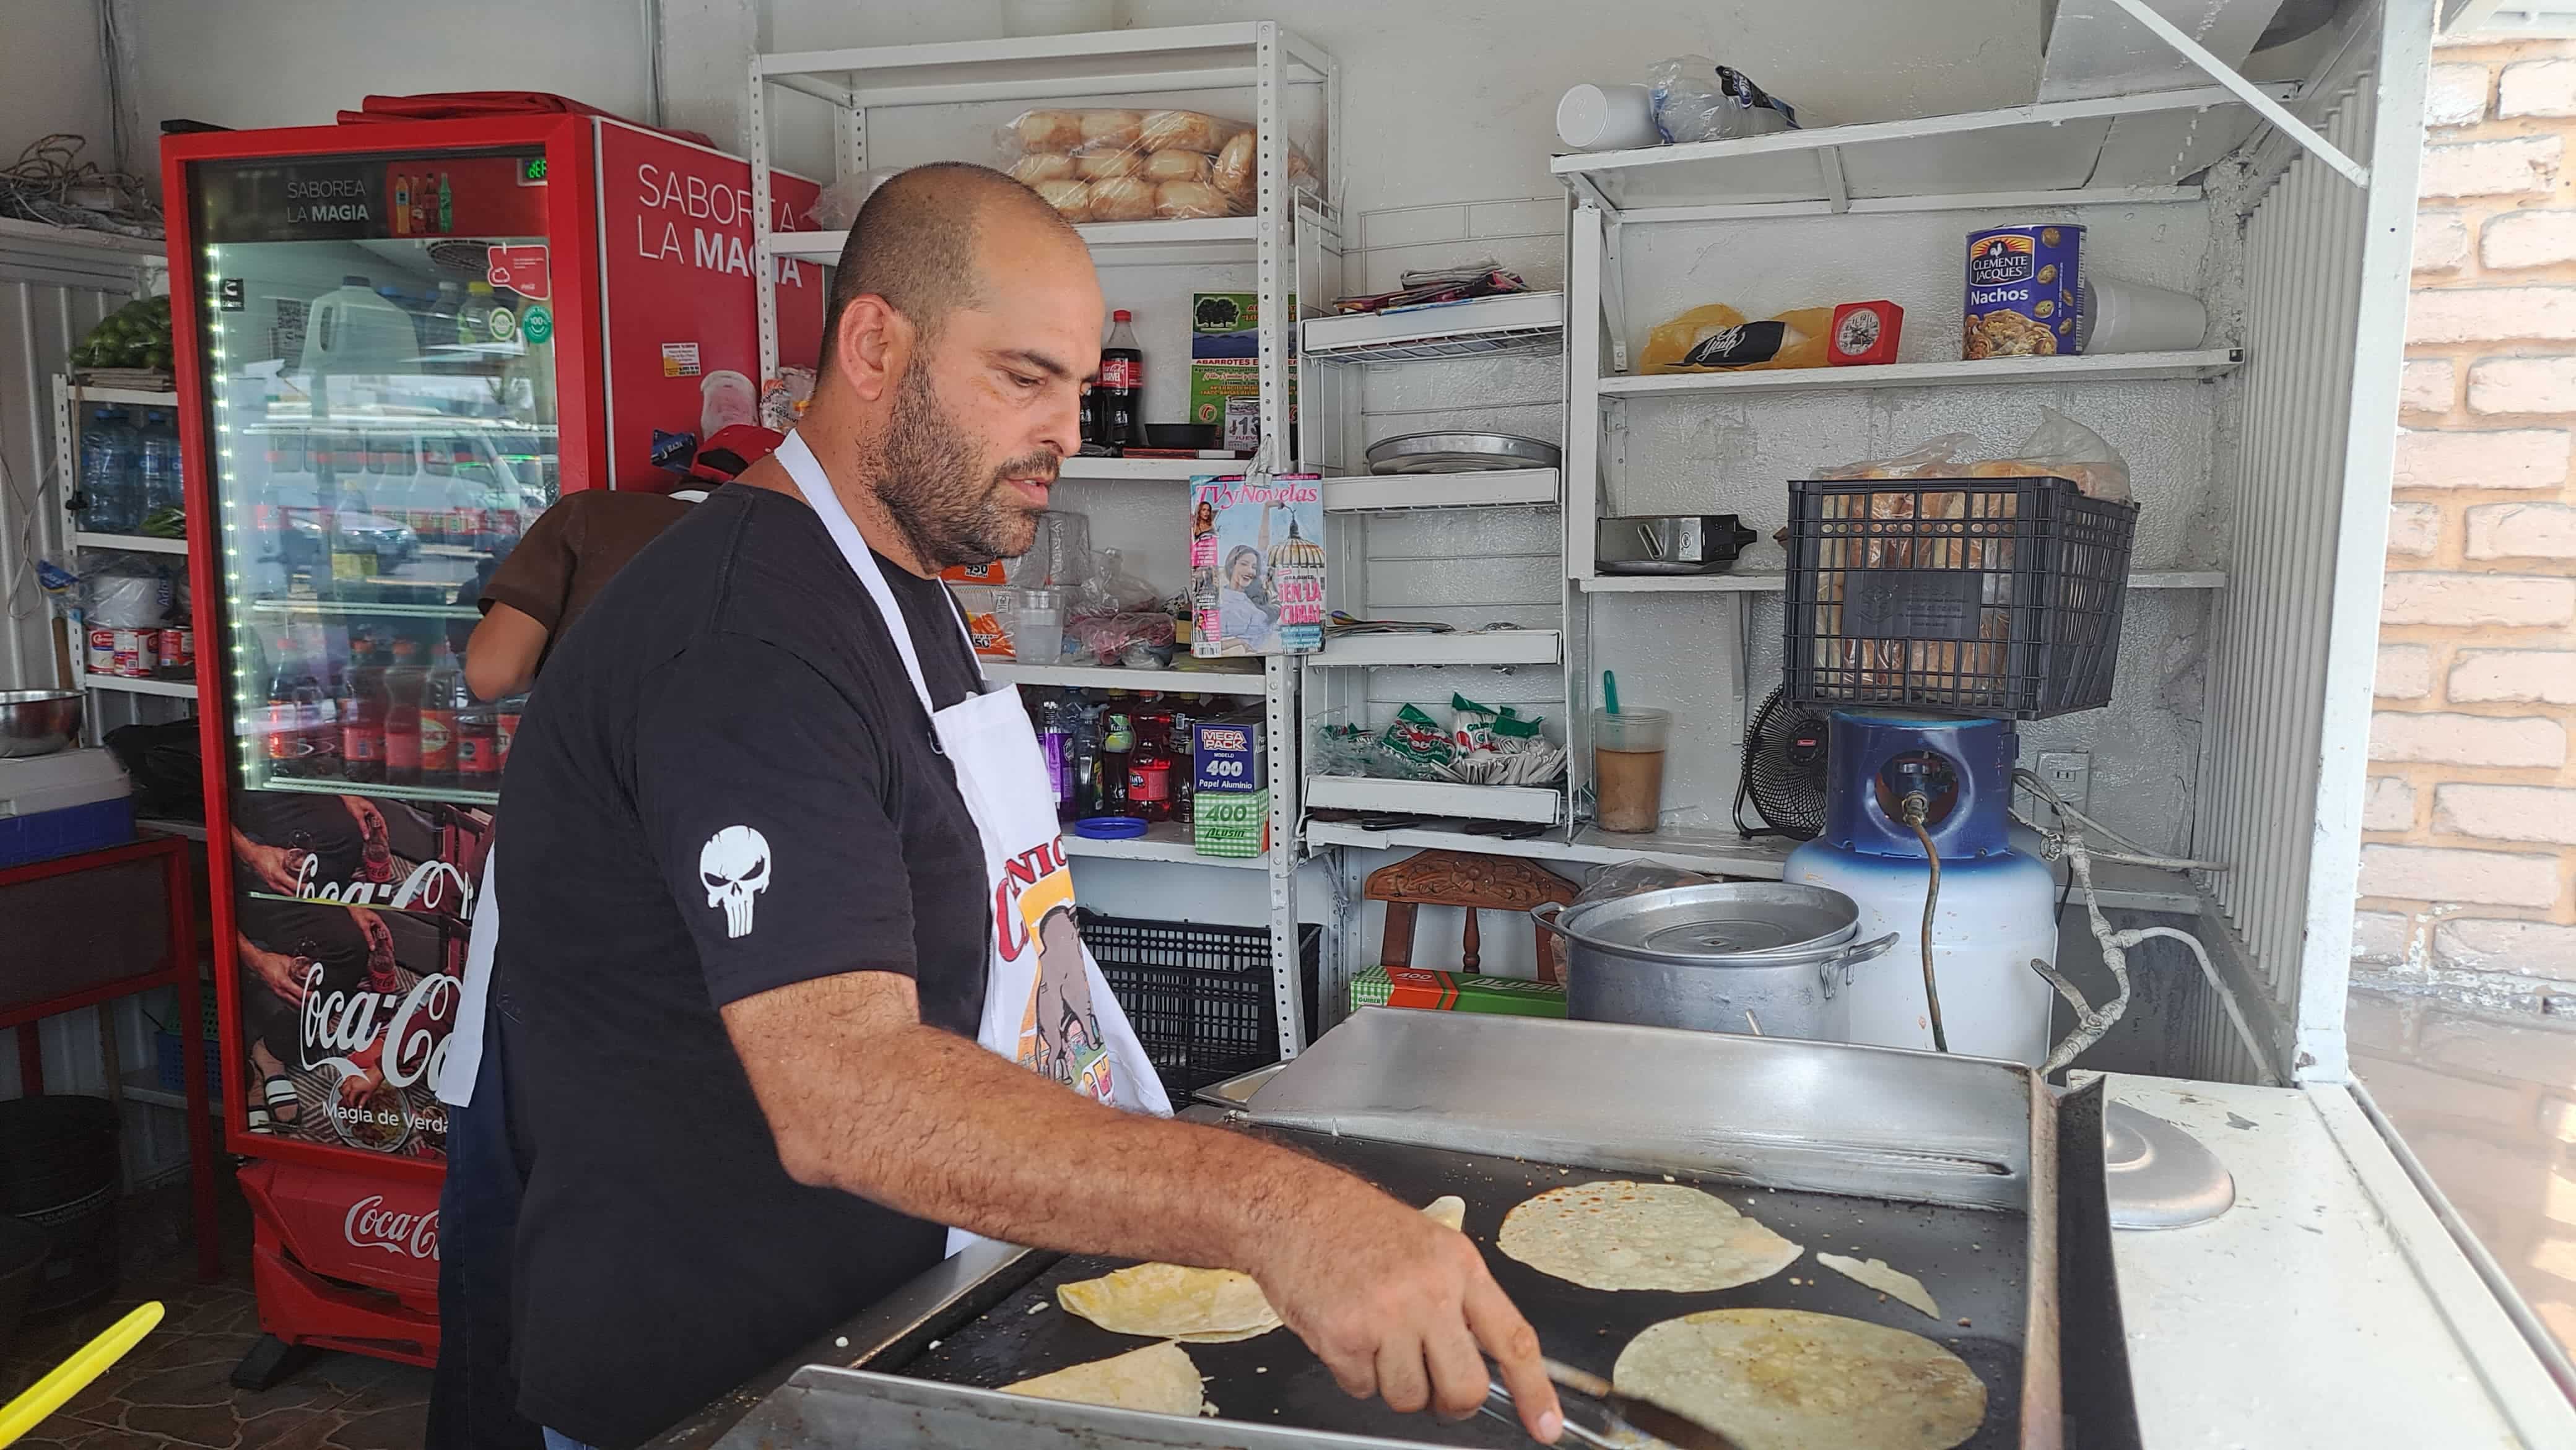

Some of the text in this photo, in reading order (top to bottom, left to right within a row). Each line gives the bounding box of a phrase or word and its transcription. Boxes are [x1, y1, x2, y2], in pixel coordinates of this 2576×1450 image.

[287, 180, 366, 199] SABOREA
[638, 163, 796, 232] SABORA
[287, 204, 370, 223] LA MAGIA
[638, 214, 803, 289] LA MAIA
[1973, 256, 2027, 271] CLEMENTE
[1975, 266, 2023, 284] JACQUES
[1970, 287, 2029, 306] Nachos
[1203, 731, 1244, 741] MEGA
[1205, 740, 1245, 750] PACK
[1206, 760, 1243, 776] 400
[1199, 779, 1253, 789] Papel Aluminio
[1204, 804, 1247, 822] 400
[1396, 972, 1434, 980] 400
[322, 1101, 373, 1125] Magia
[378, 1109, 399, 1126] de
[344, 1195, 440, 1261] Coca-C
